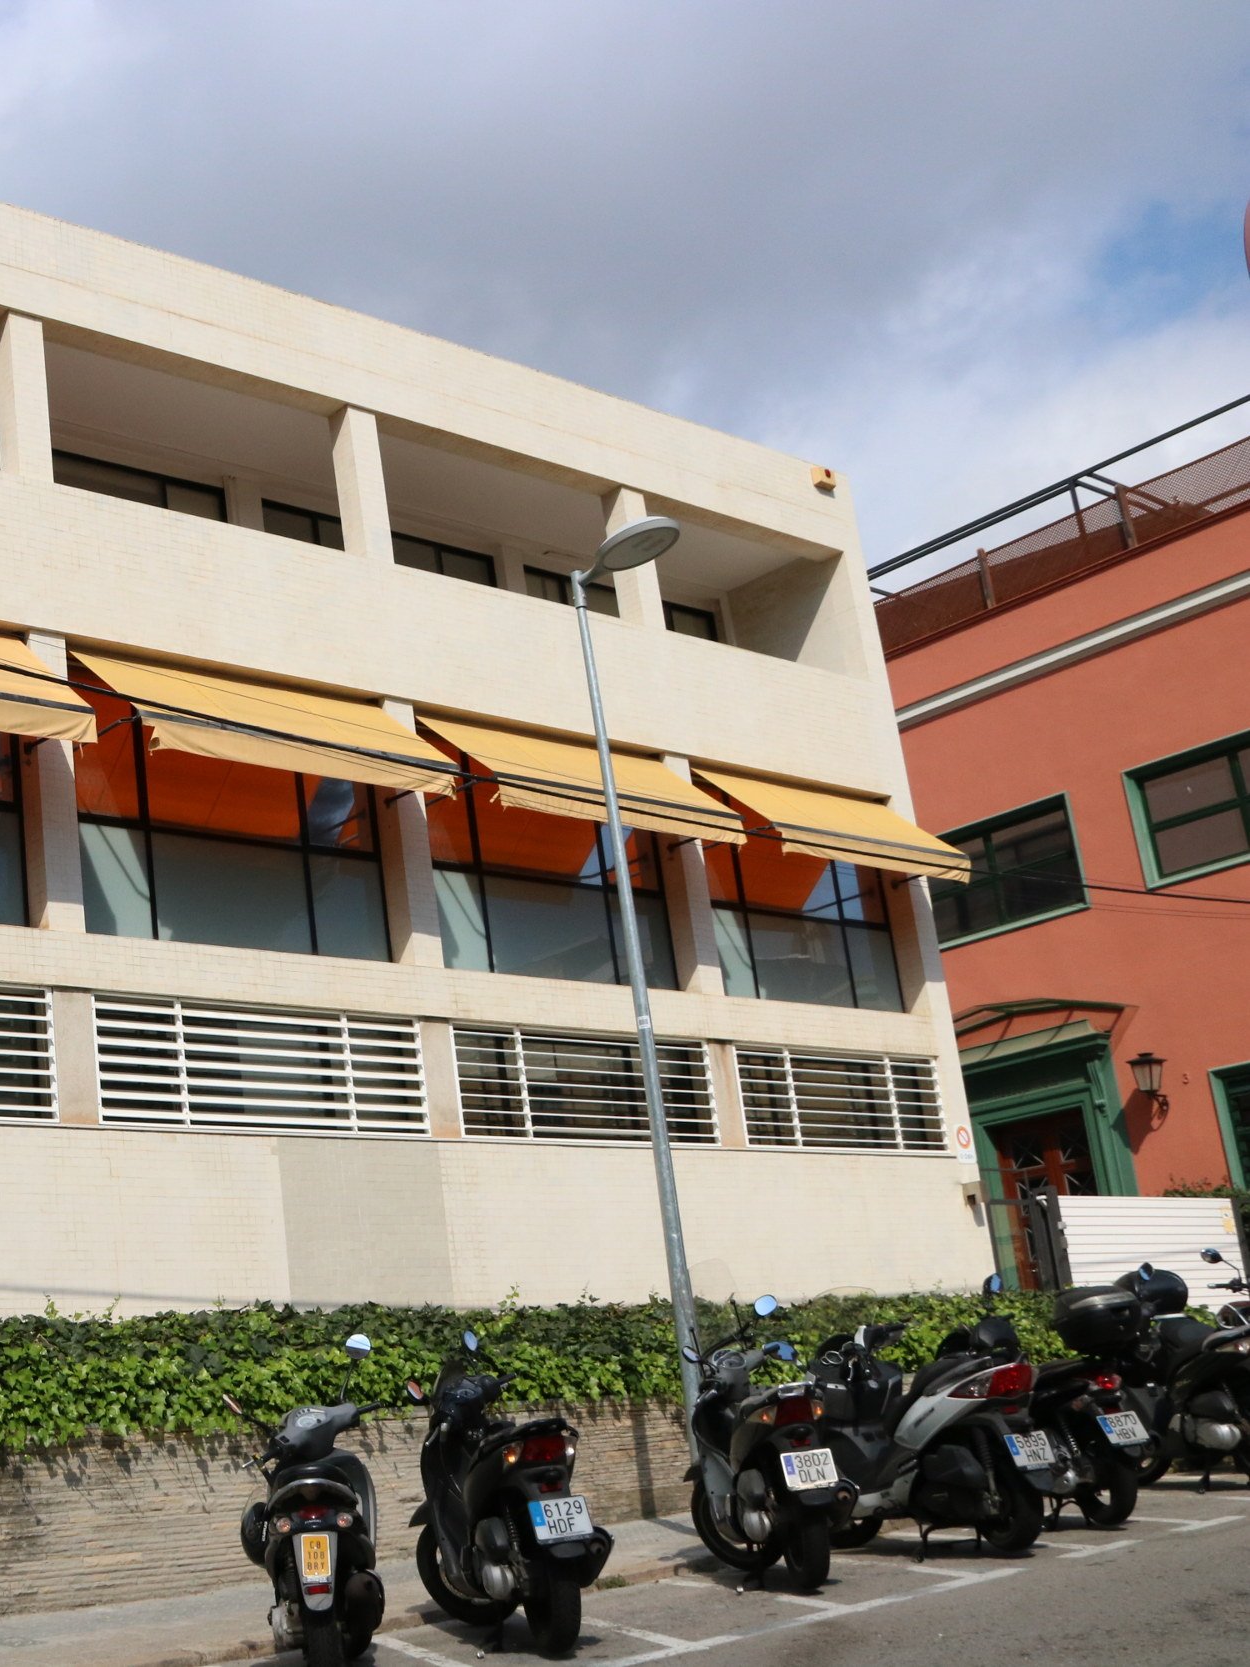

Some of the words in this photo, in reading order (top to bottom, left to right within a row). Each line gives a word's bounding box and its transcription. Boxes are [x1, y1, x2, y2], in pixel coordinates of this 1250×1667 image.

[1107, 1413, 1137, 1428] 8870
[1015, 1433, 1047, 1449] 5895
[794, 1452, 831, 1469] 3802
[1024, 1447, 1050, 1462] HNZ
[798, 1467, 827, 1483] DLN
[543, 1500, 583, 1518] 6129
[547, 1516, 575, 1535] HDF
